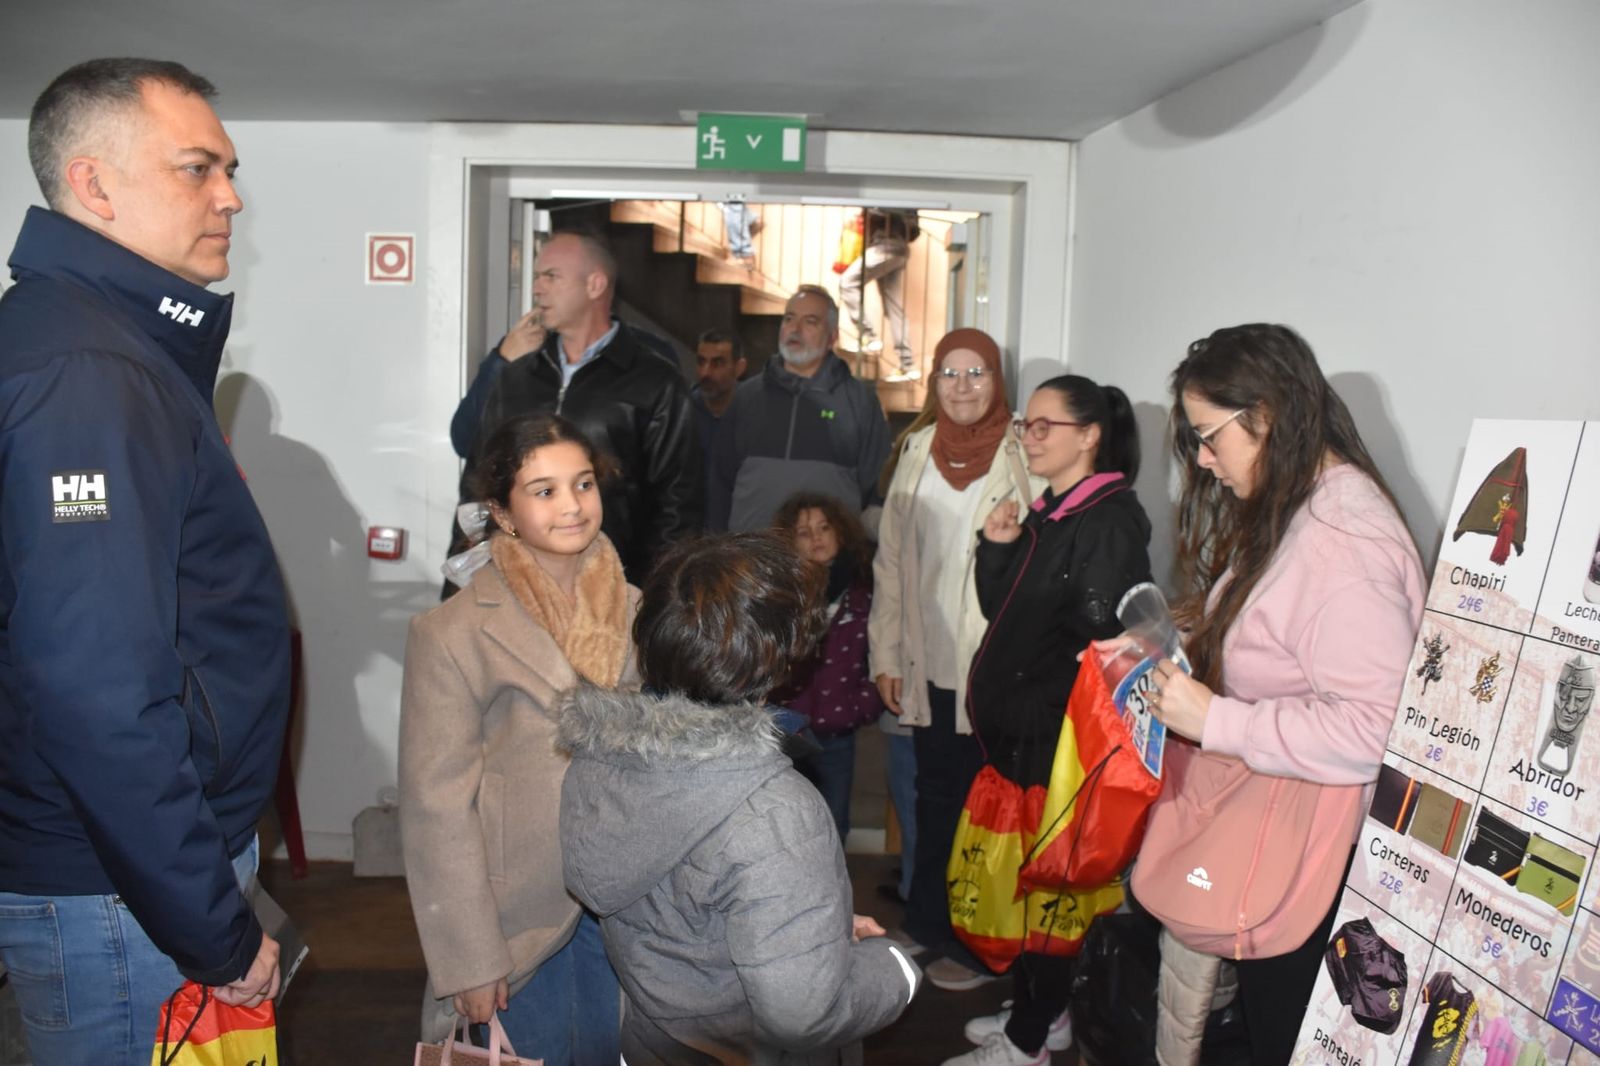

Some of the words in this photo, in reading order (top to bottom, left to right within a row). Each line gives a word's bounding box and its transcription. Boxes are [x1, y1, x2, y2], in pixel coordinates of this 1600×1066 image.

[158, 296, 205, 327] HH
[52, 474, 106, 502] HH
[54, 505, 79, 513] HELLY
[1450, 566, 1507, 593] Chapiri
[1457, 594, 1484, 613] 24€
[1564, 602, 1600, 622] Lech
[1550, 626, 1600, 651] Pantera
[1404, 706, 1427, 729] Pin
[1429, 717, 1481, 751] Legión
[1425, 744, 1443, 762] 2€
[1508, 758, 1585, 801] Abridor
[1526, 796, 1549, 817] 3€
[1370, 837, 1430, 883] Carteras
[1379, 871, 1404, 894] 22€
[1455, 887, 1552, 958] Monederos
[1481, 935, 1503, 959] 5€
